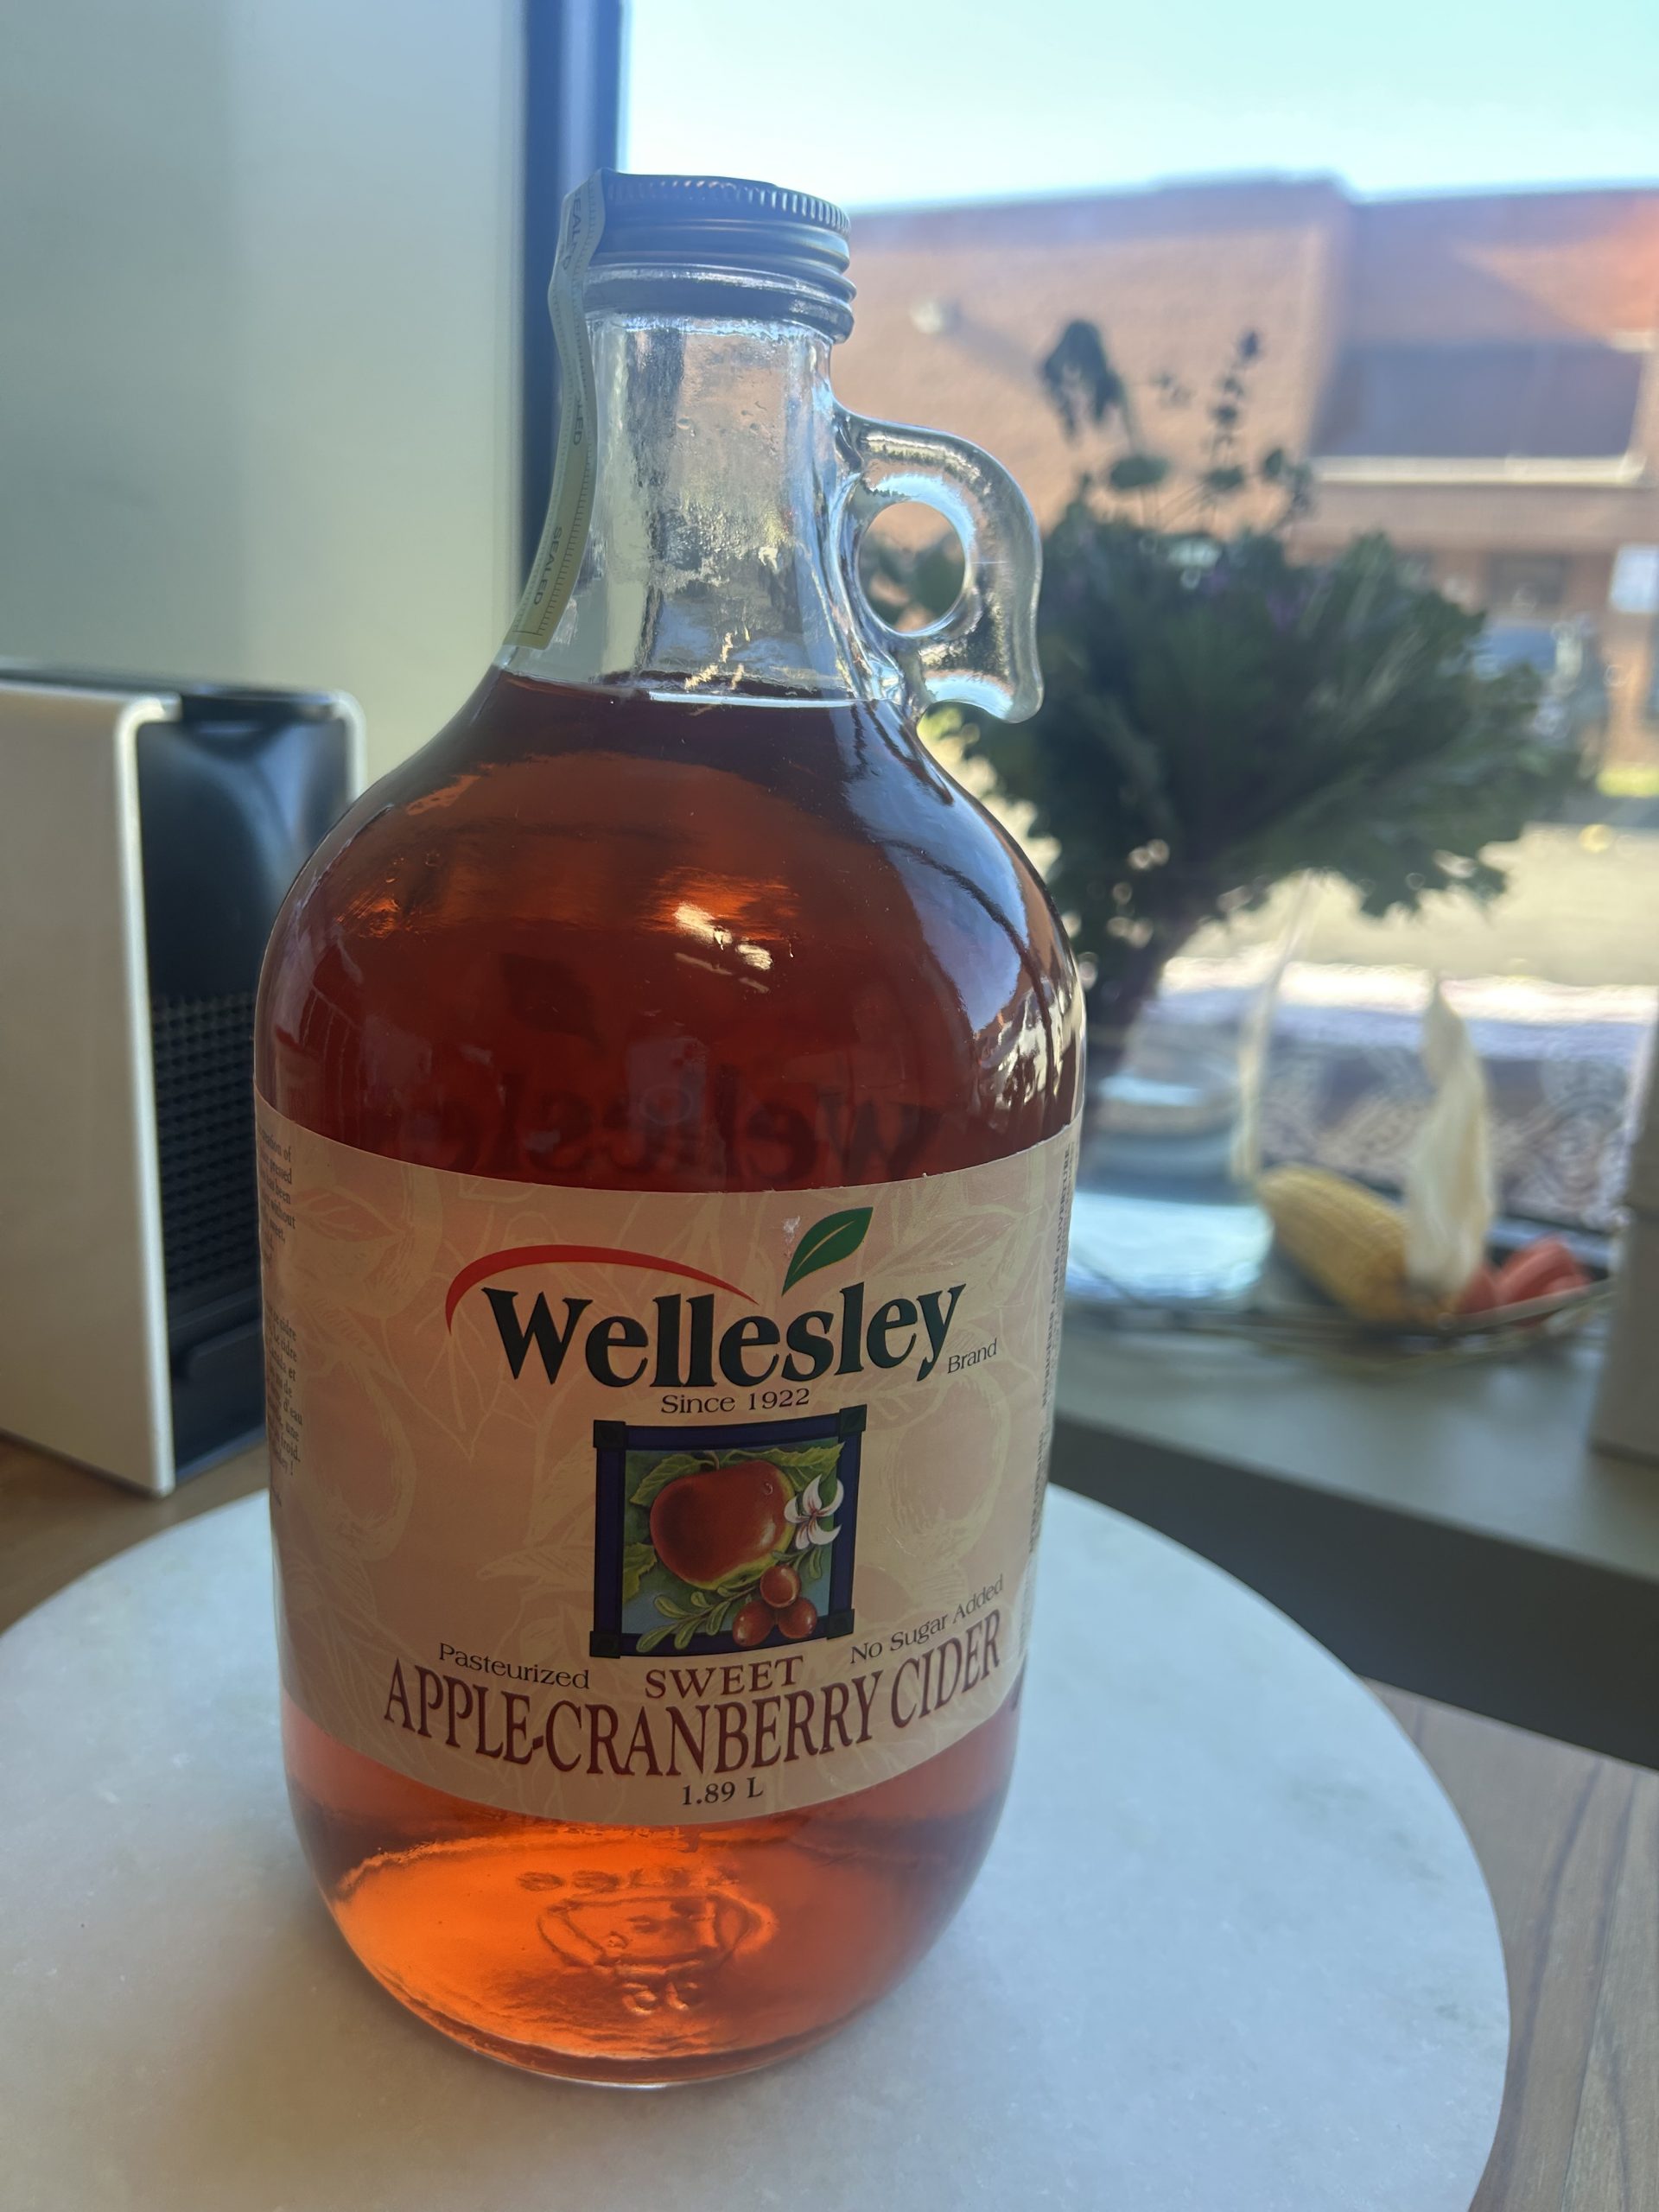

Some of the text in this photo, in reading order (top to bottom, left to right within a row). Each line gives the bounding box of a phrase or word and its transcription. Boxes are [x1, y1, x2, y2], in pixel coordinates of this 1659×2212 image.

[533, 525, 562, 605] SEALED
[481, 1282, 966, 1388] Wellesley
[947, 1340, 998, 1375] Brand
[660, 1388, 810, 1414] Since 1922
[850, 1574, 1004, 1664] No Sugar Added
[438, 1643, 589, 1690] Pasteurized
[645, 1656, 804, 1700] SWEET
[384, 1608, 1002, 1777] APPLE-CRANBERRY CIDER
[683, 1777, 765, 1806] 1.89 L
